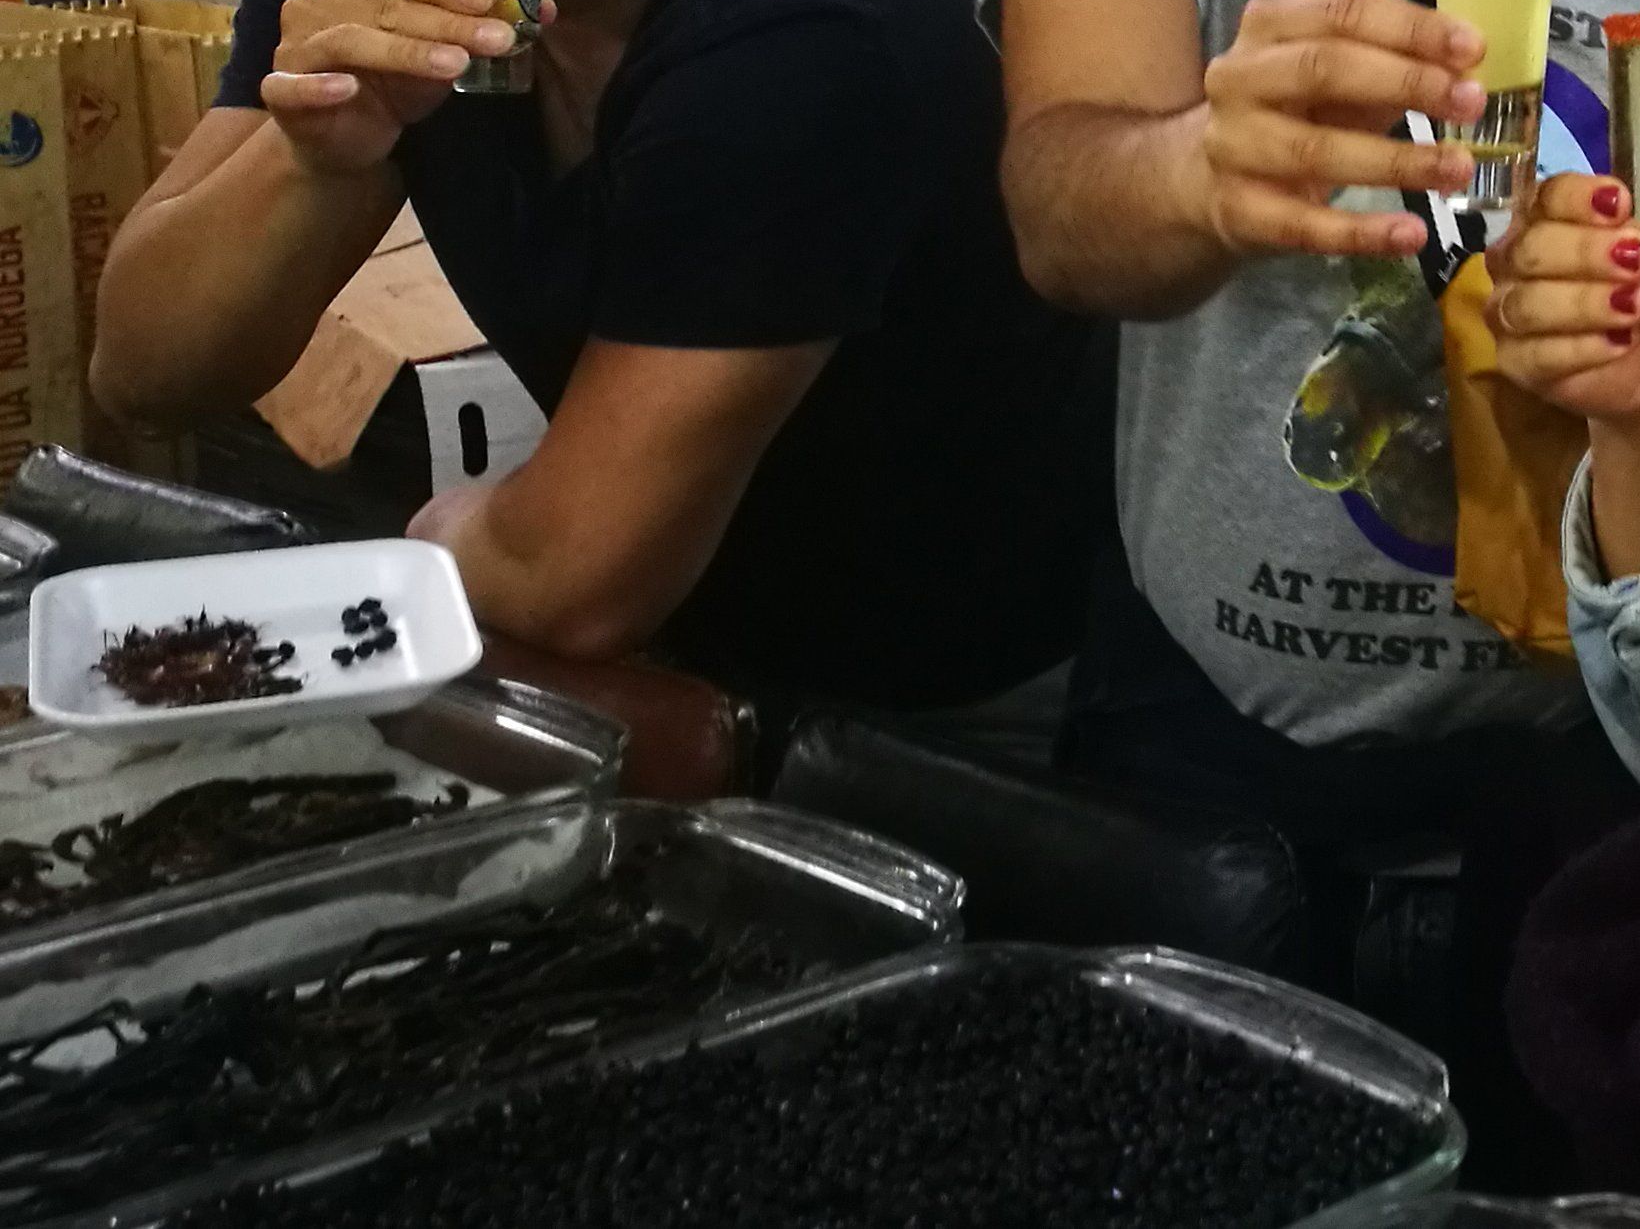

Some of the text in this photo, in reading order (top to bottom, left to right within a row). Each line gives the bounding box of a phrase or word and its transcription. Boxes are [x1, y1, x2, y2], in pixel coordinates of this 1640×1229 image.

[1249, 563, 1313, 605] AT
[1326, 579, 1437, 617] THE
[1215, 597, 1448, 671] HARVEST
